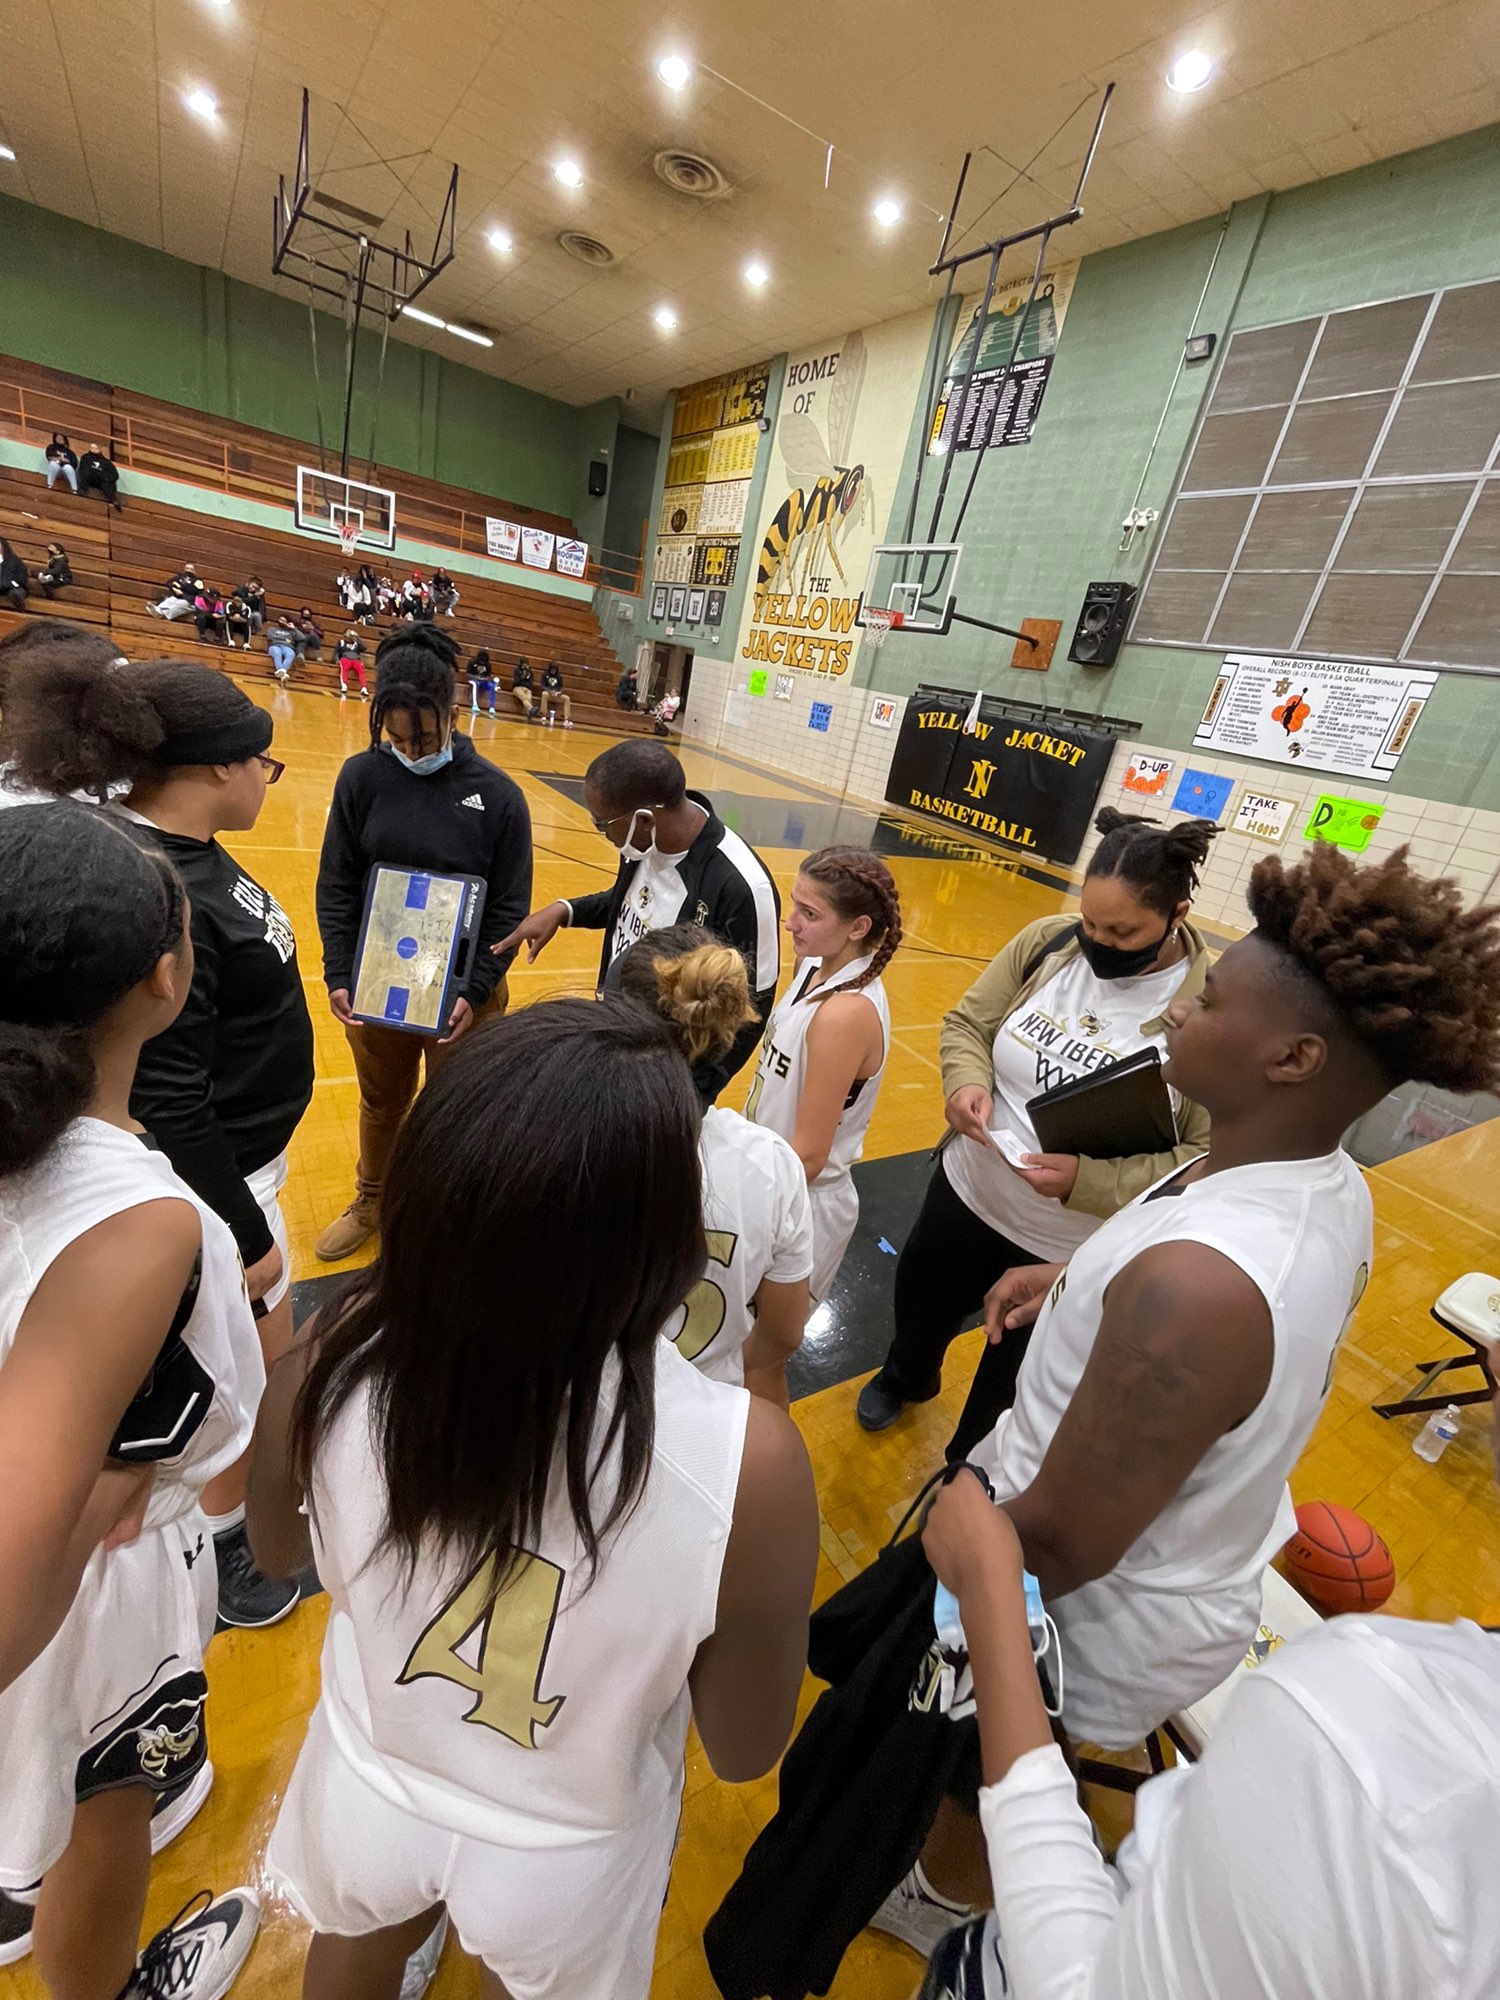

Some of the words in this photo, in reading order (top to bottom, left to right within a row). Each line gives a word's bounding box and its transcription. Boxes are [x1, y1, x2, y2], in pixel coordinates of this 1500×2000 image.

[787, 353, 840, 388] HOME
[793, 391, 816, 414] OF
[809, 577, 831, 593] THE
[752, 592, 861, 634] YELLOW
[742, 629, 853, 676] JACKETS
[1314, 664, 1371, 674] BASKETBALL
[1394, 708, 1416, 747] 2012
[1004, 729, 1087, 768] JACKET
[1139, 760, 1169, 773] D-UP
[909, 789, 1037, 848] BASKETBALL
[1240, 806, 1259, 818] IT
[1247, 795, 1279, 810] TAKE
[1246, 820, 1279, 836] HOOP
[1018, 1013, 1064, 1047] NEW
[394, 1543, 567, 1750] 4
